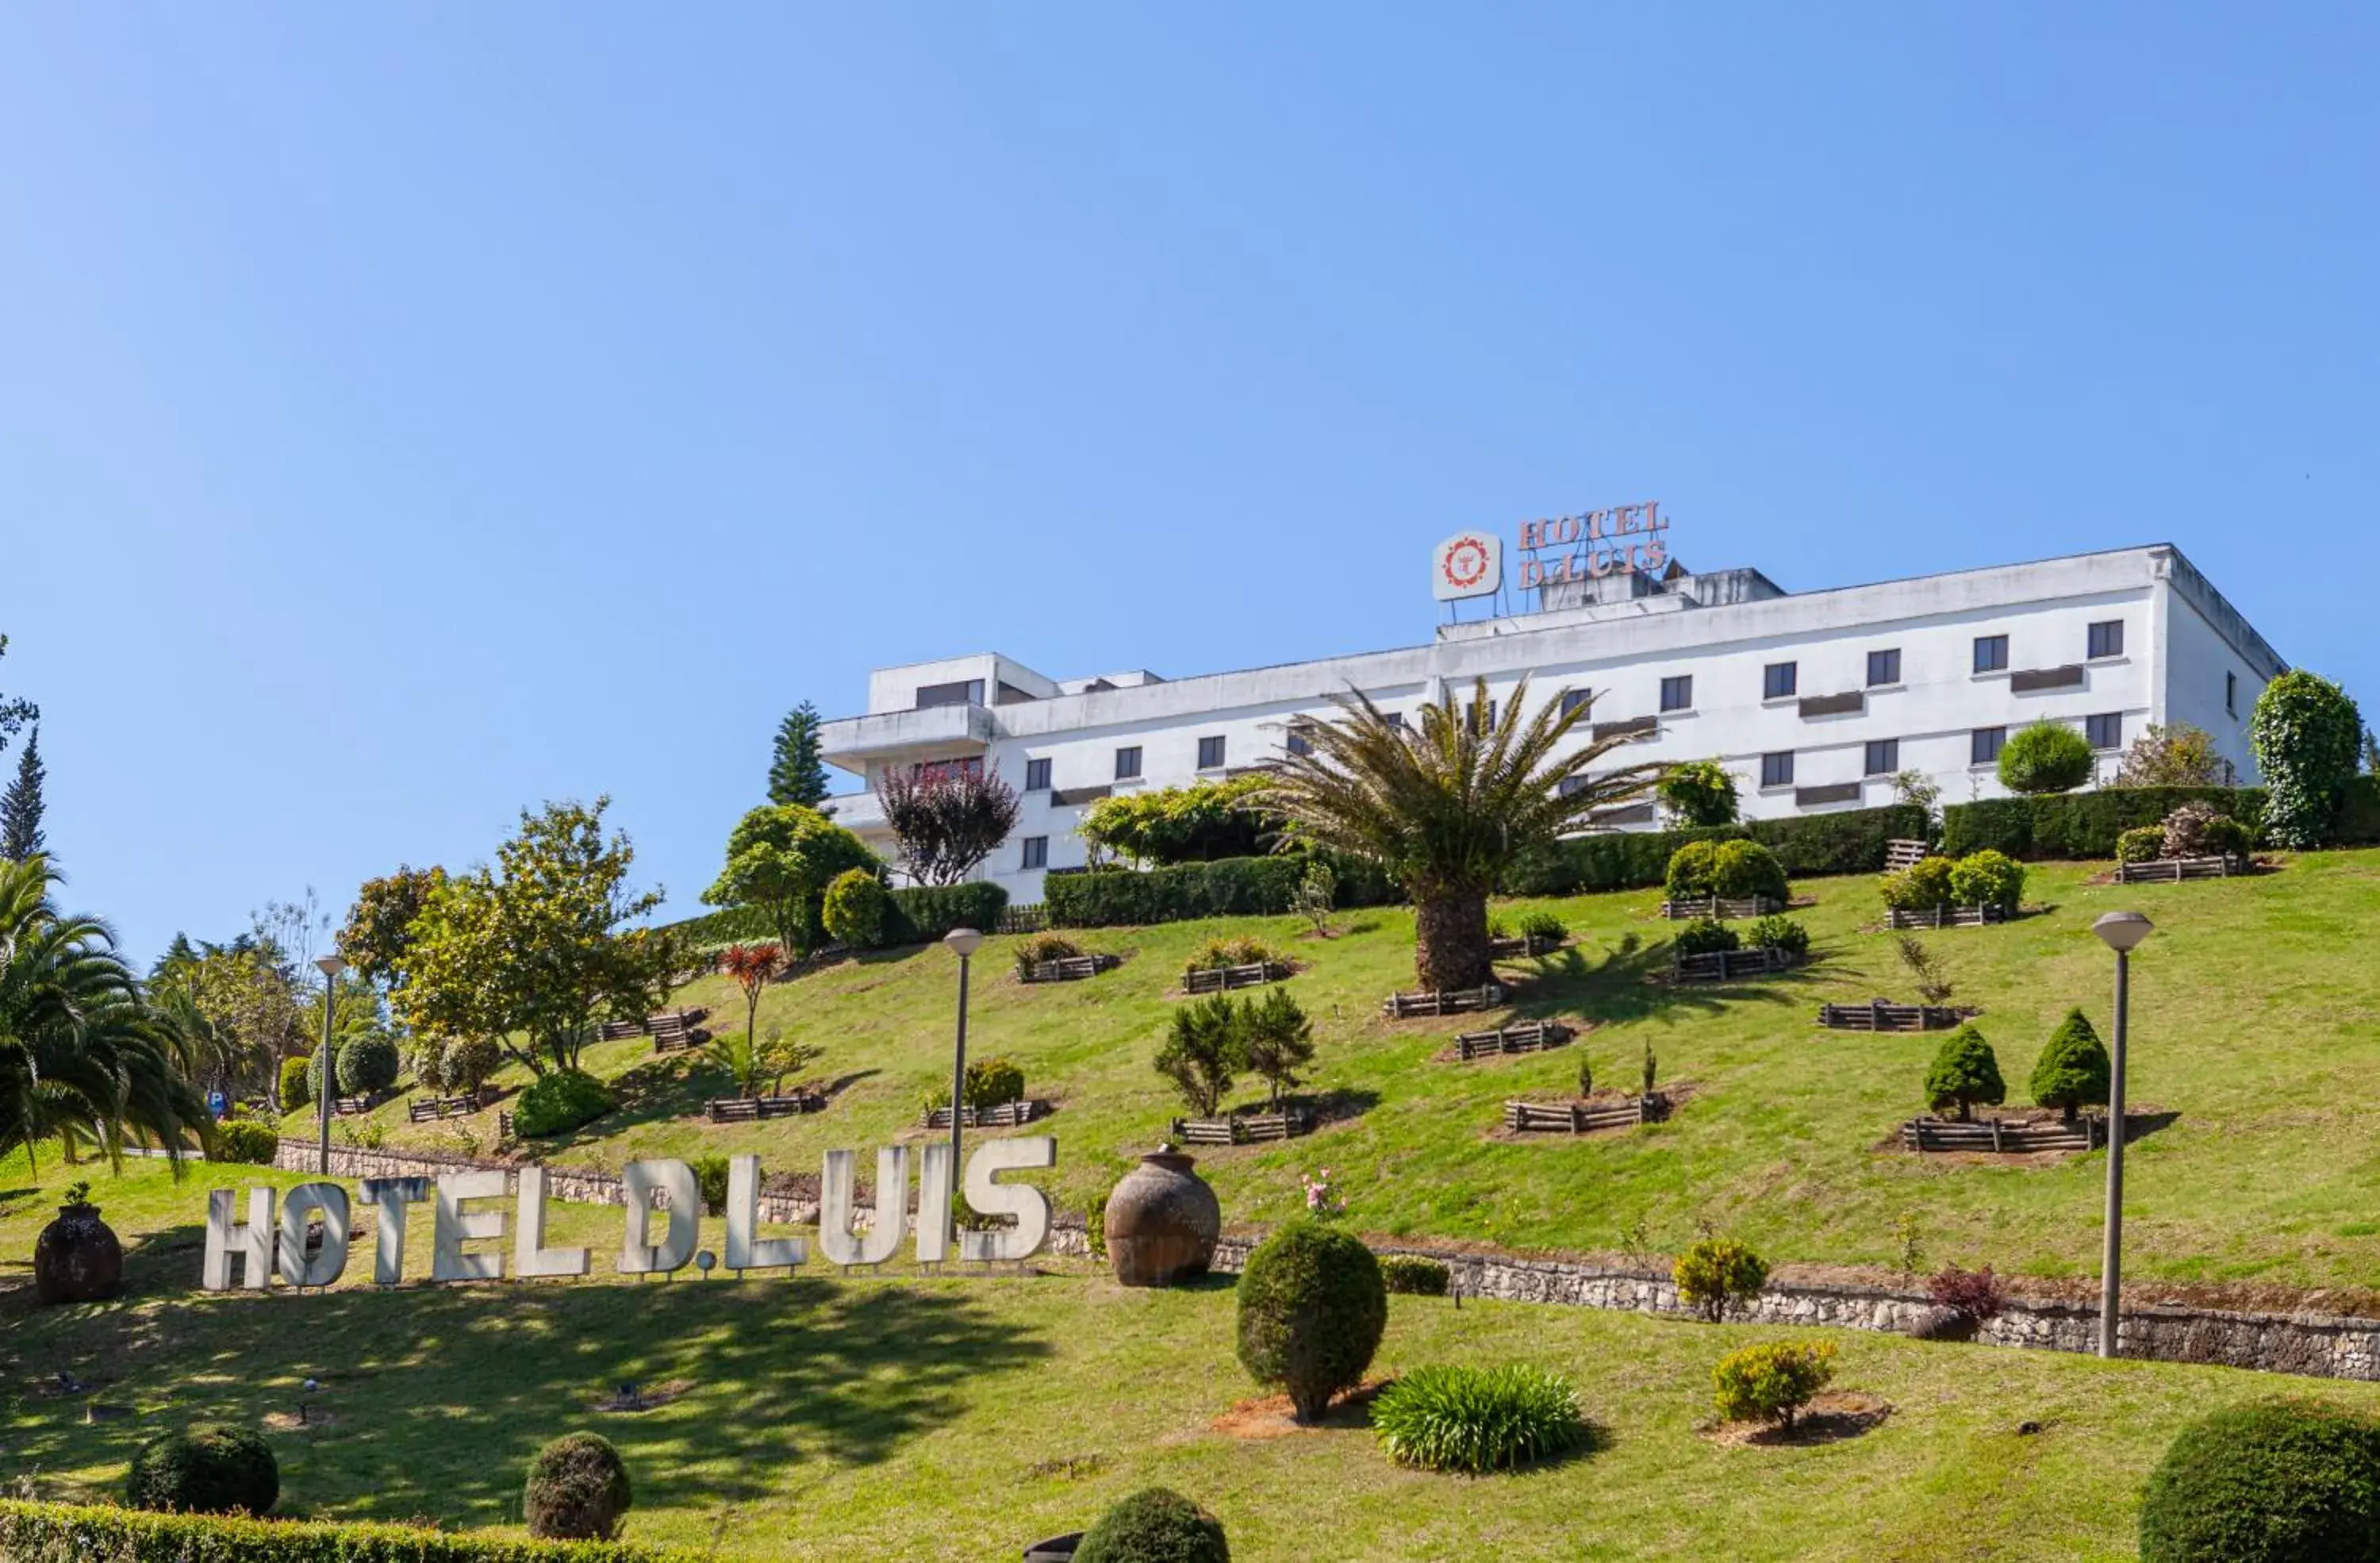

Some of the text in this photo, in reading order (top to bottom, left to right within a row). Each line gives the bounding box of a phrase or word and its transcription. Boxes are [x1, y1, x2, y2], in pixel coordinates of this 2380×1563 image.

[1518, 501, 1669, 549] HOTEL
[212, 1093, 223, 1104] P
[202, 1167, 589, 1290] HOTEL
